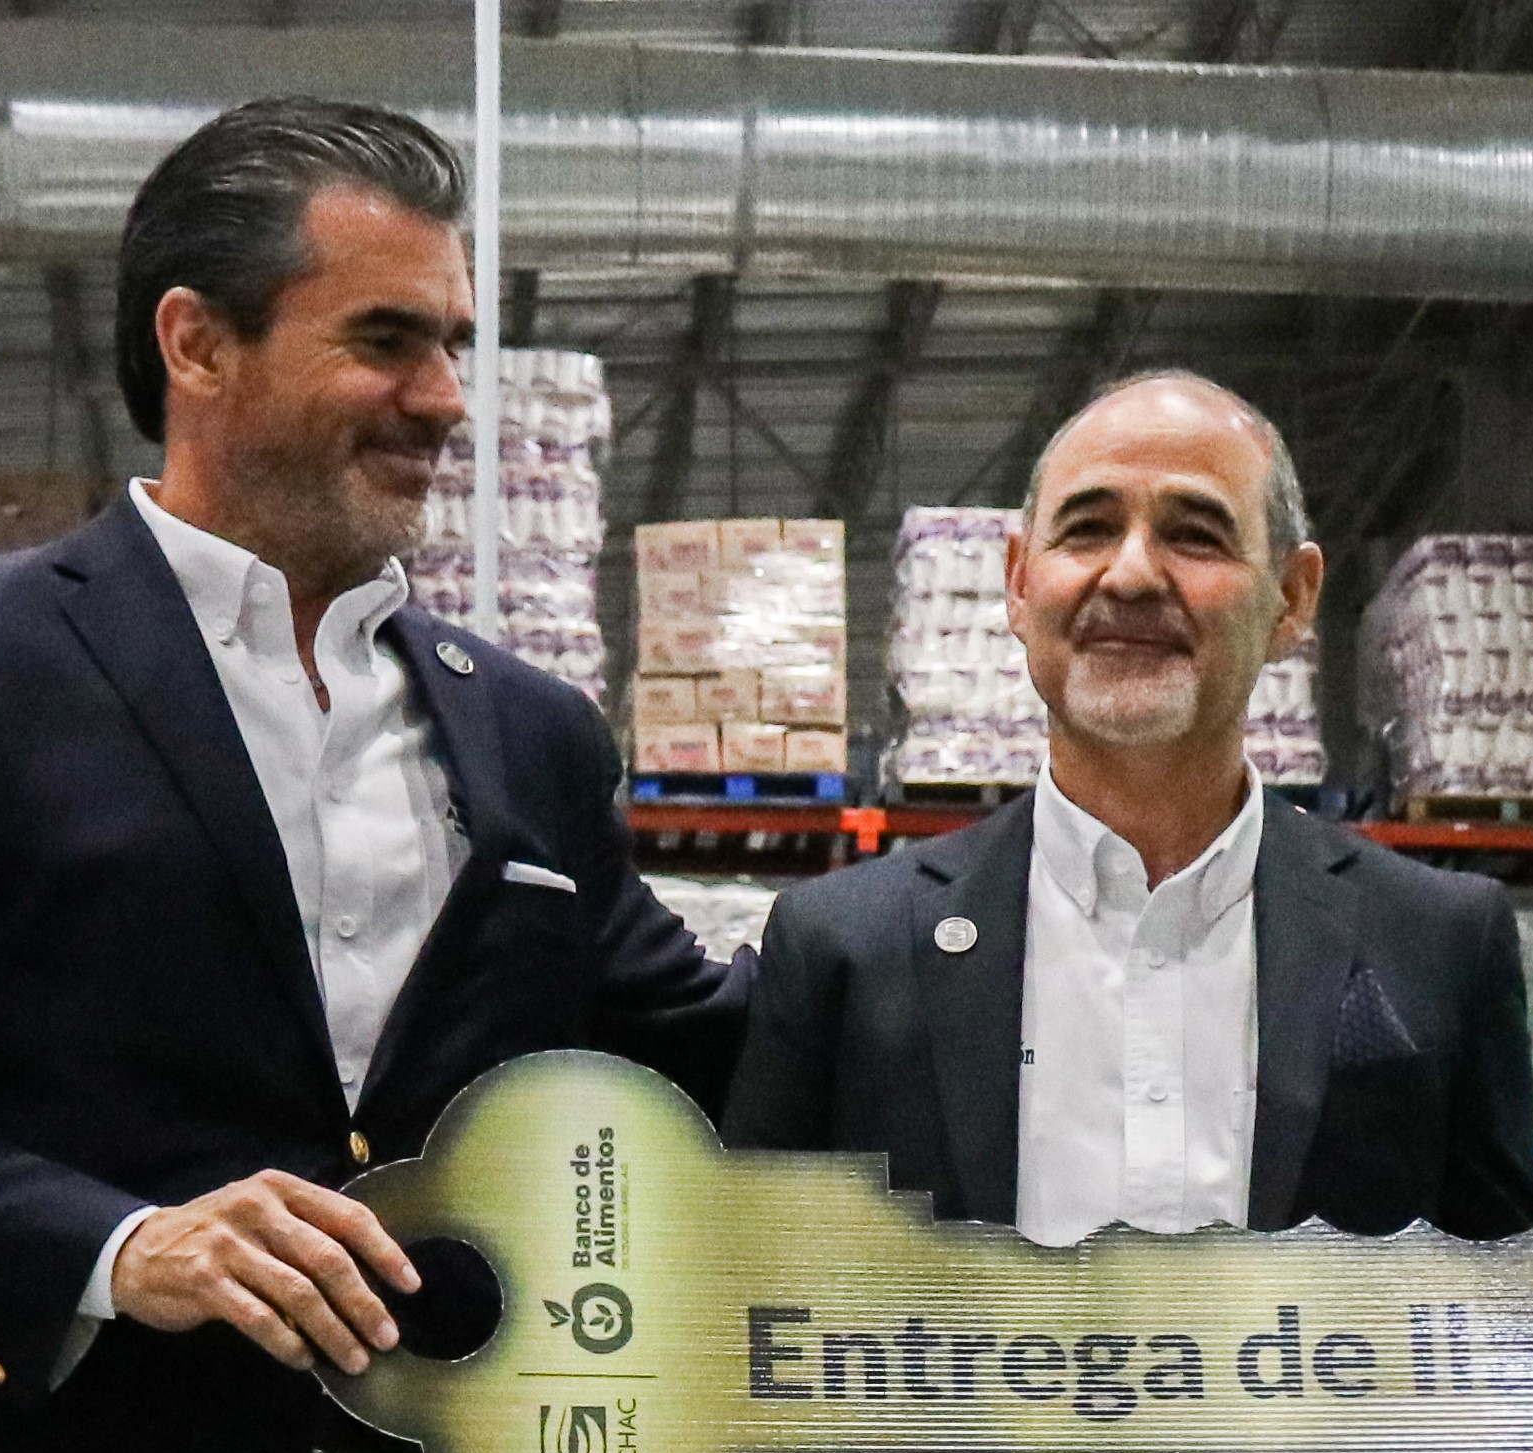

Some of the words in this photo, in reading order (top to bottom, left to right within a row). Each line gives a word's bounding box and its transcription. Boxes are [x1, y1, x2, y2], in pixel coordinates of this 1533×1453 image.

[570, 1144, 591, 1178] de
[594, 1127, 616, 1268] Alimentos
[572, 1184, 592, 1268] Banco
[748, 1306, 1205, 1421] Entrega
[1236, 1304, 1378, 1398] de
